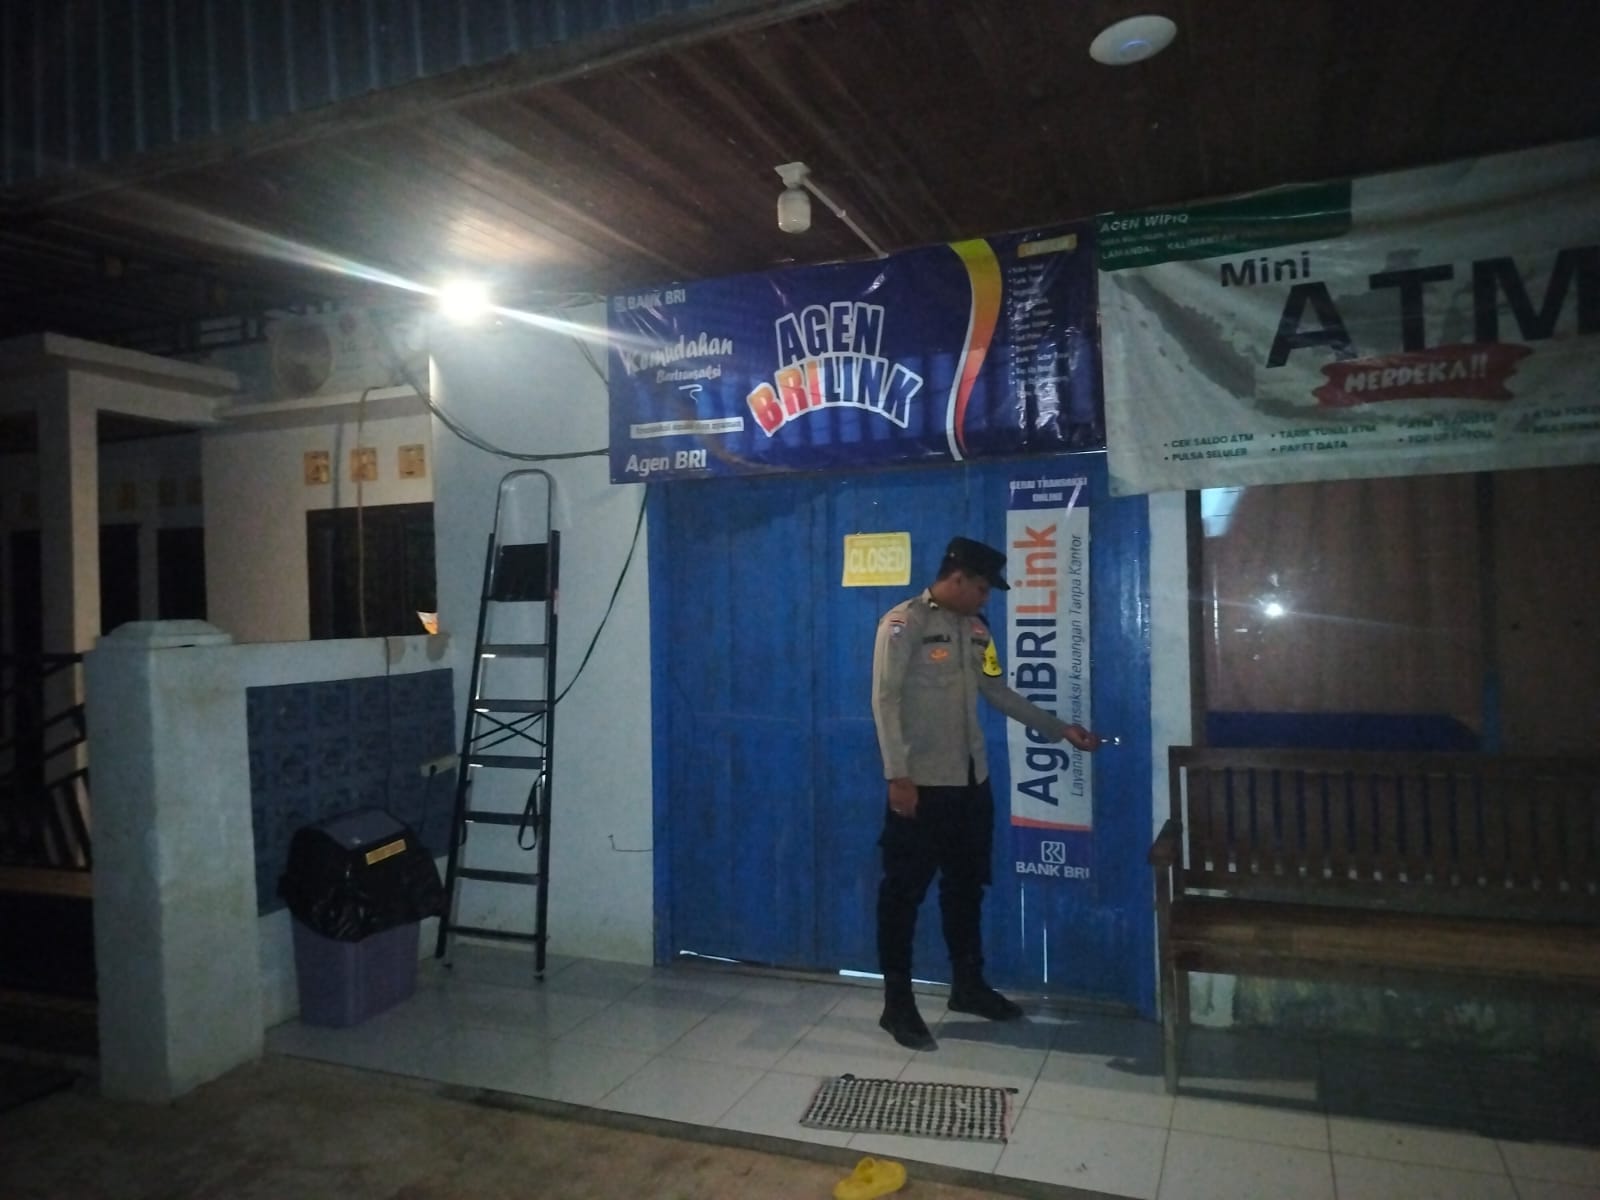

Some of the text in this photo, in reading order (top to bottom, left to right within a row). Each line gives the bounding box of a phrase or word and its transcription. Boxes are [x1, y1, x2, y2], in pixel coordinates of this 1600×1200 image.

[1221, 251, 1310, 287] Mini
[627, 288, 687, 310] BANK BRI
[1267, 244, 1600, 368] ATM
[775, 301, 885, 370] AGEN
[1343, 352, 1489, 394] MERDEKA!!
[746, 356, 924, 438] BRILINK
[1172, 447, 1248, 461] PULSA SELULER
[1194, 435, 1229, 446] SALDO
[1230, 433, 1254, 443] ATM
[1317, 440, 1348, 450] DATA
[625, 449, 707, 477] Agen BRI
[850, 546, 906, 573] CLOSED
[1068, 534, 1083, 576] Kantor
[1069, 580, 1085, 616] Tanpa
[1069, 620, 1086, 680] keuangan
[1015, 861, 1090, 879] BANK BRI
